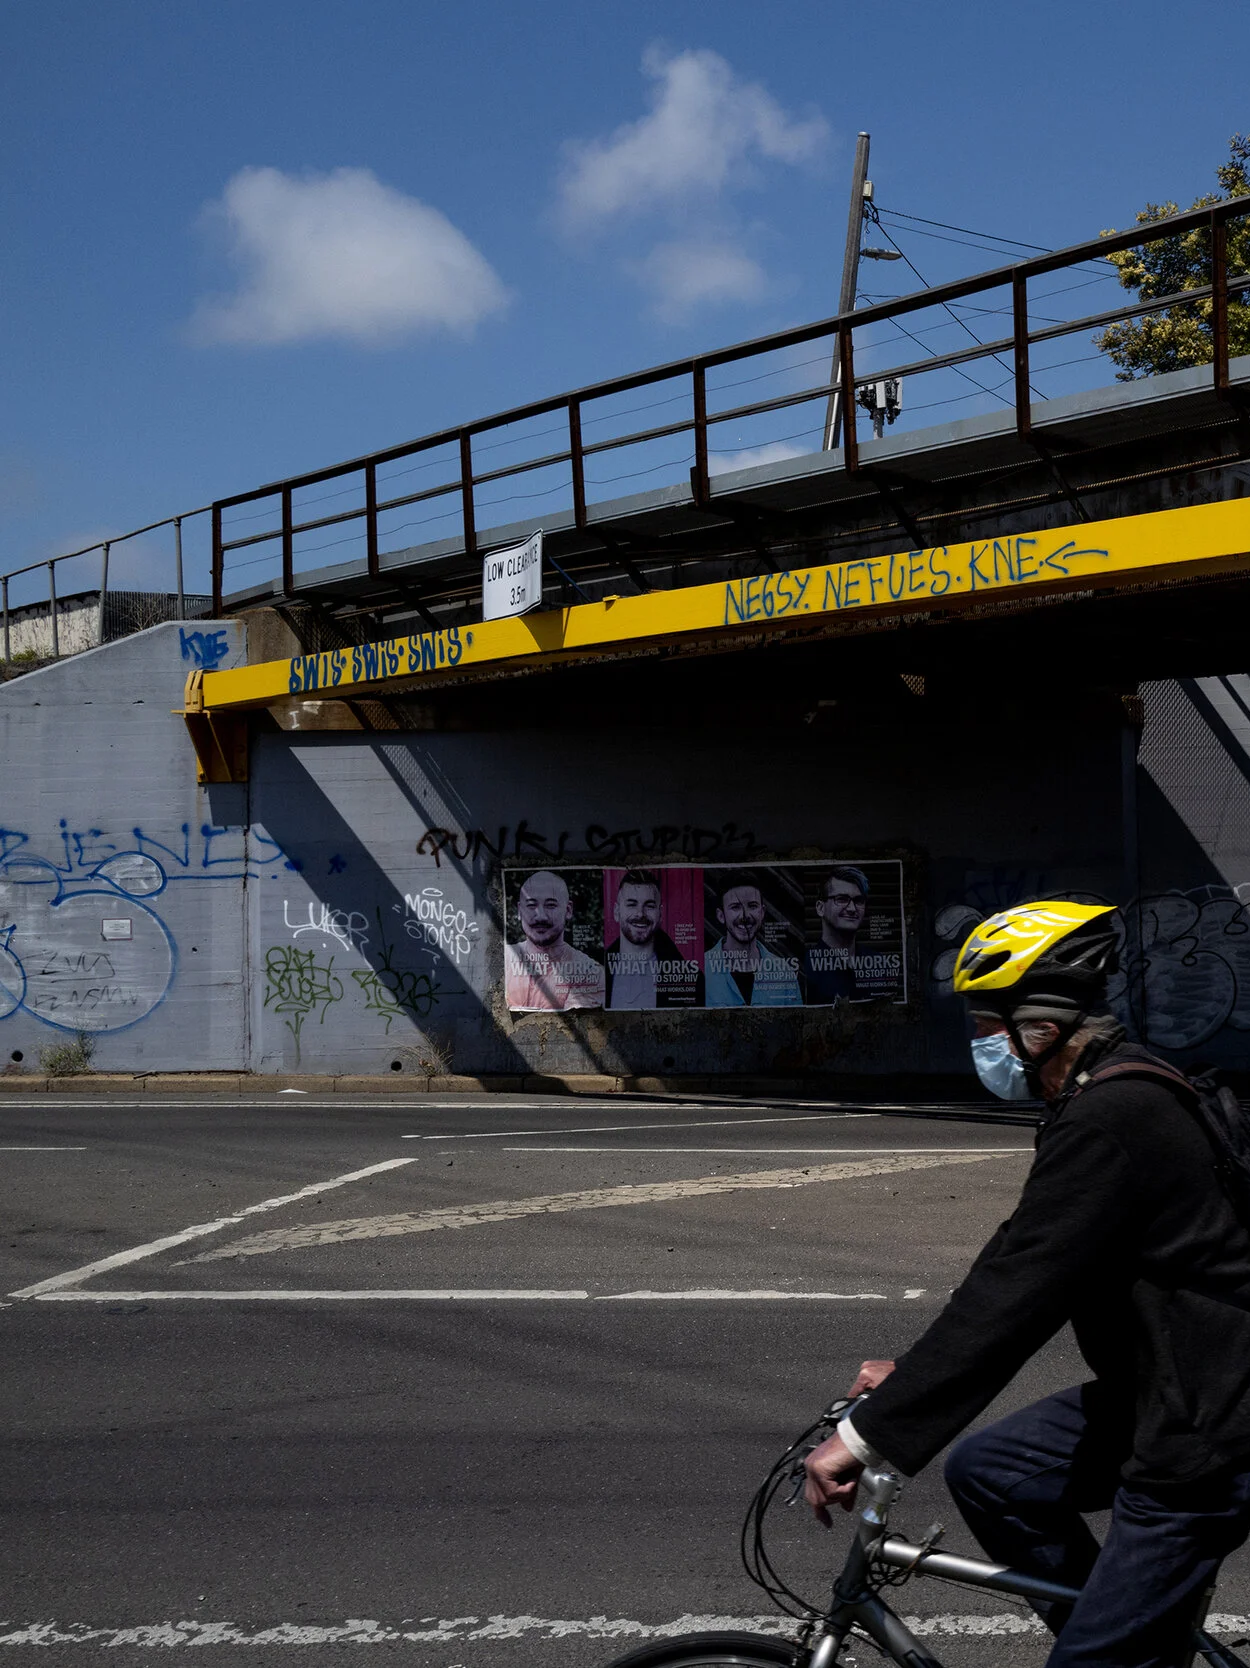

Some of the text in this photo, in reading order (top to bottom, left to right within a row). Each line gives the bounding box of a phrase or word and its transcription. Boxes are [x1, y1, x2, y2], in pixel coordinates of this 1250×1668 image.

[488, 561, 504, 582] LOW
[405, 893, 467, 934] MONGO
[403, 919, 471, 963] STOMP
[524, 953, 549, 961] DOING
[607, 952, 647, 961] I'M DOING
[708, 950, 748, 959] I'M DOING
[809, 948, 848, 957] I'M DOING
[511, 960, 600, 976] WHAT WORKS
[608, 960, 699, 975] WHAT WORKS
[709, 957, 799, 973] WHAT WORKS
[810, 954, 901, 972] WHAT WORKS
[753, 971, 799, 980] TO STOP HIV
[854, 968, 900, 978] TO STOP HIV
[555, 975, 599, 984] TO STOP HIV
[652, 974, 699, 983] TO STOP HIV
